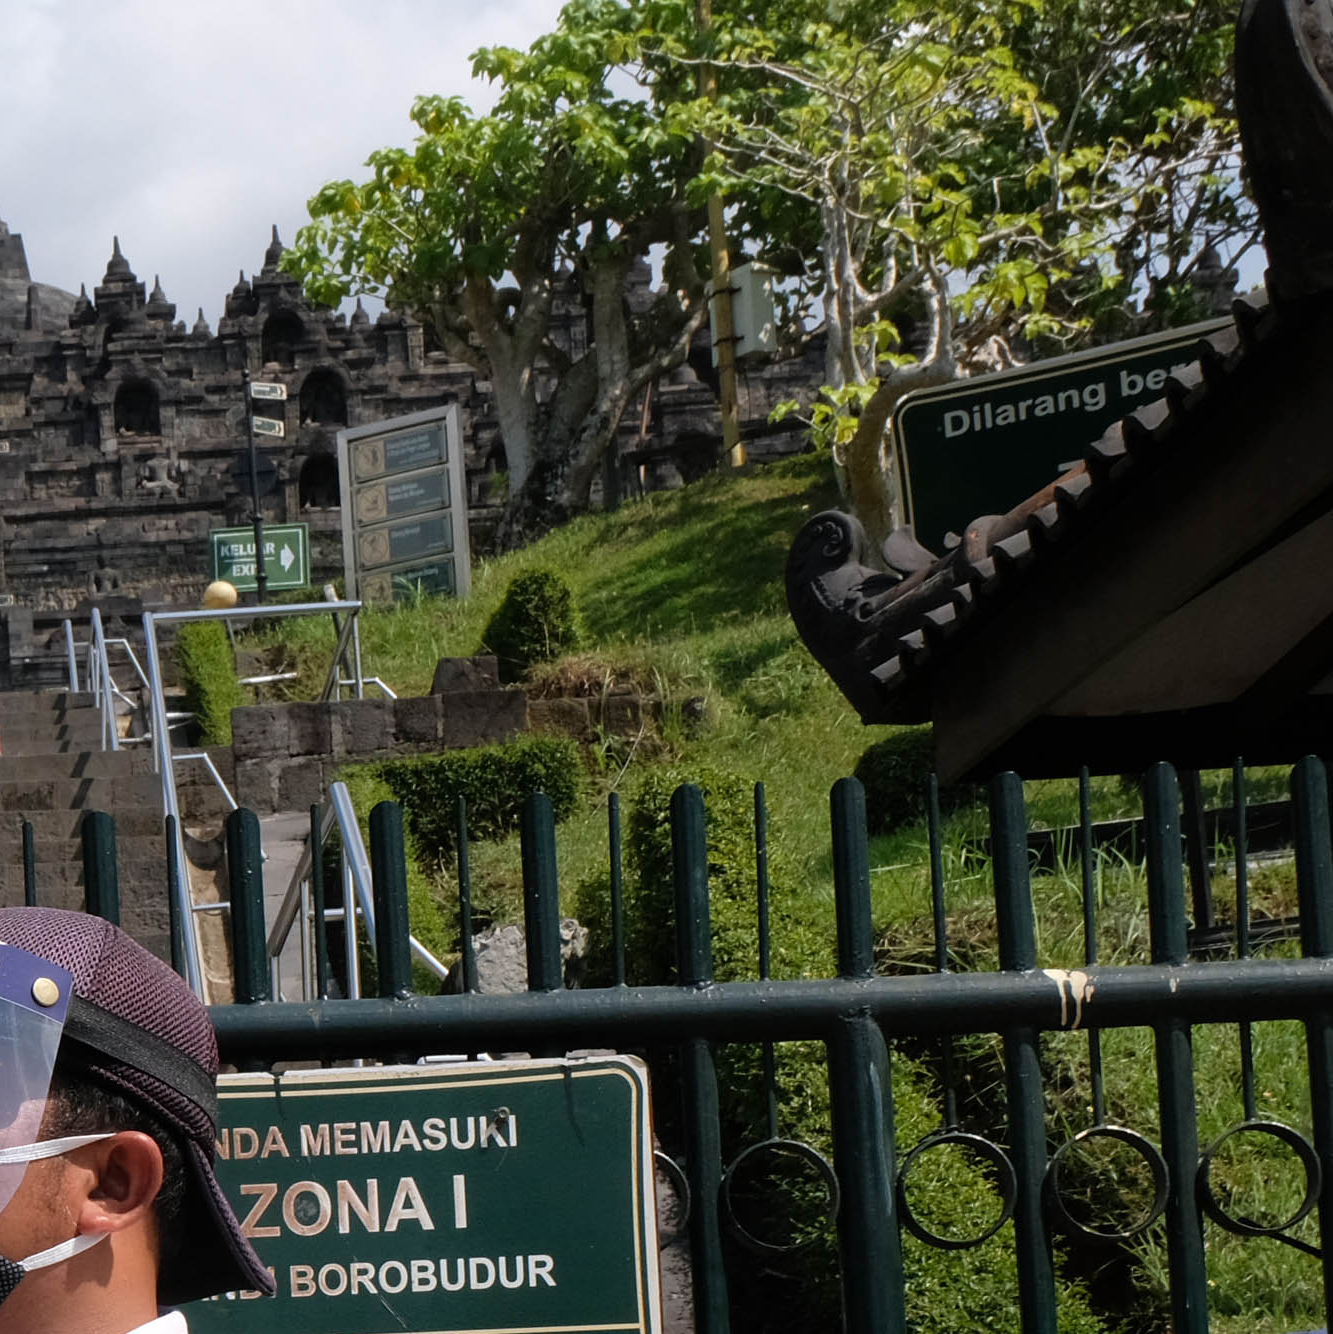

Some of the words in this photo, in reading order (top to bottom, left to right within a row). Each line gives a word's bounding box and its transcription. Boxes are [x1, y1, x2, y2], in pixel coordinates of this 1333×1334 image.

[943, 381, 1107, 439] Dilarang
[220, 542, 275, 557] KELUR
[232, 563, 258, 577] EXI
[215, 1126, 289, 1160] NDA
[300, 1114, 518, 1156] MEMASUKI
[239, 1176, 434, 1238] ZONA
[453, 1174, 469, 1229] I
[290, 1254, 557, 1299] BOROBUDUR
